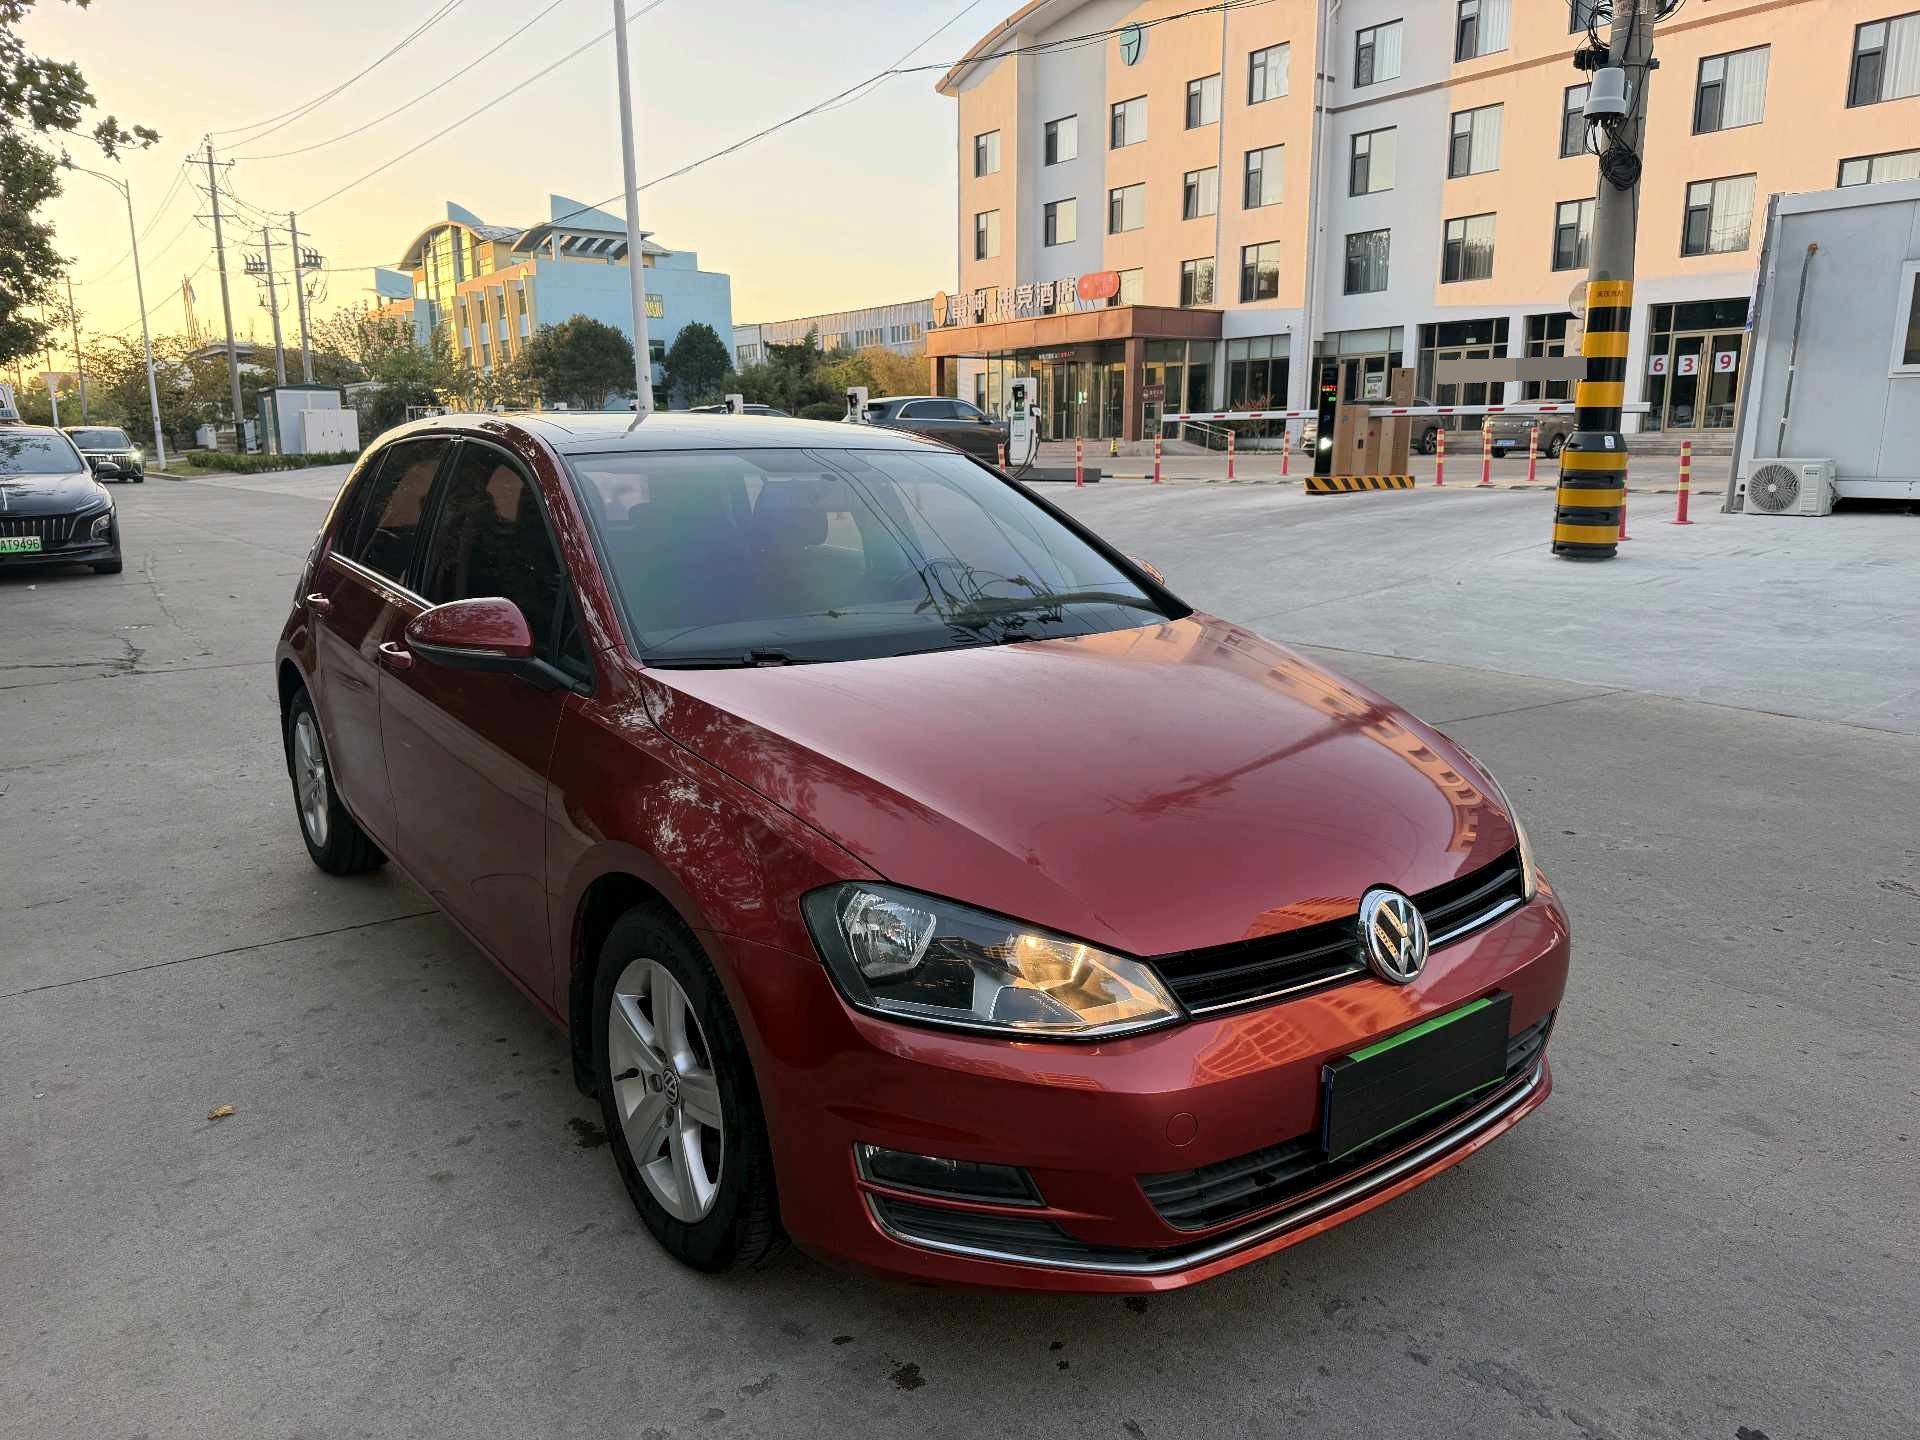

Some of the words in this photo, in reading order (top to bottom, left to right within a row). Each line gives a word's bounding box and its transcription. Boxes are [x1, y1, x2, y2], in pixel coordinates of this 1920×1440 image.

[1653, 357, 1664, 372] 6
[1682, 357, 1694, 373] 3
[1720, 354, 1732, 370] 9
